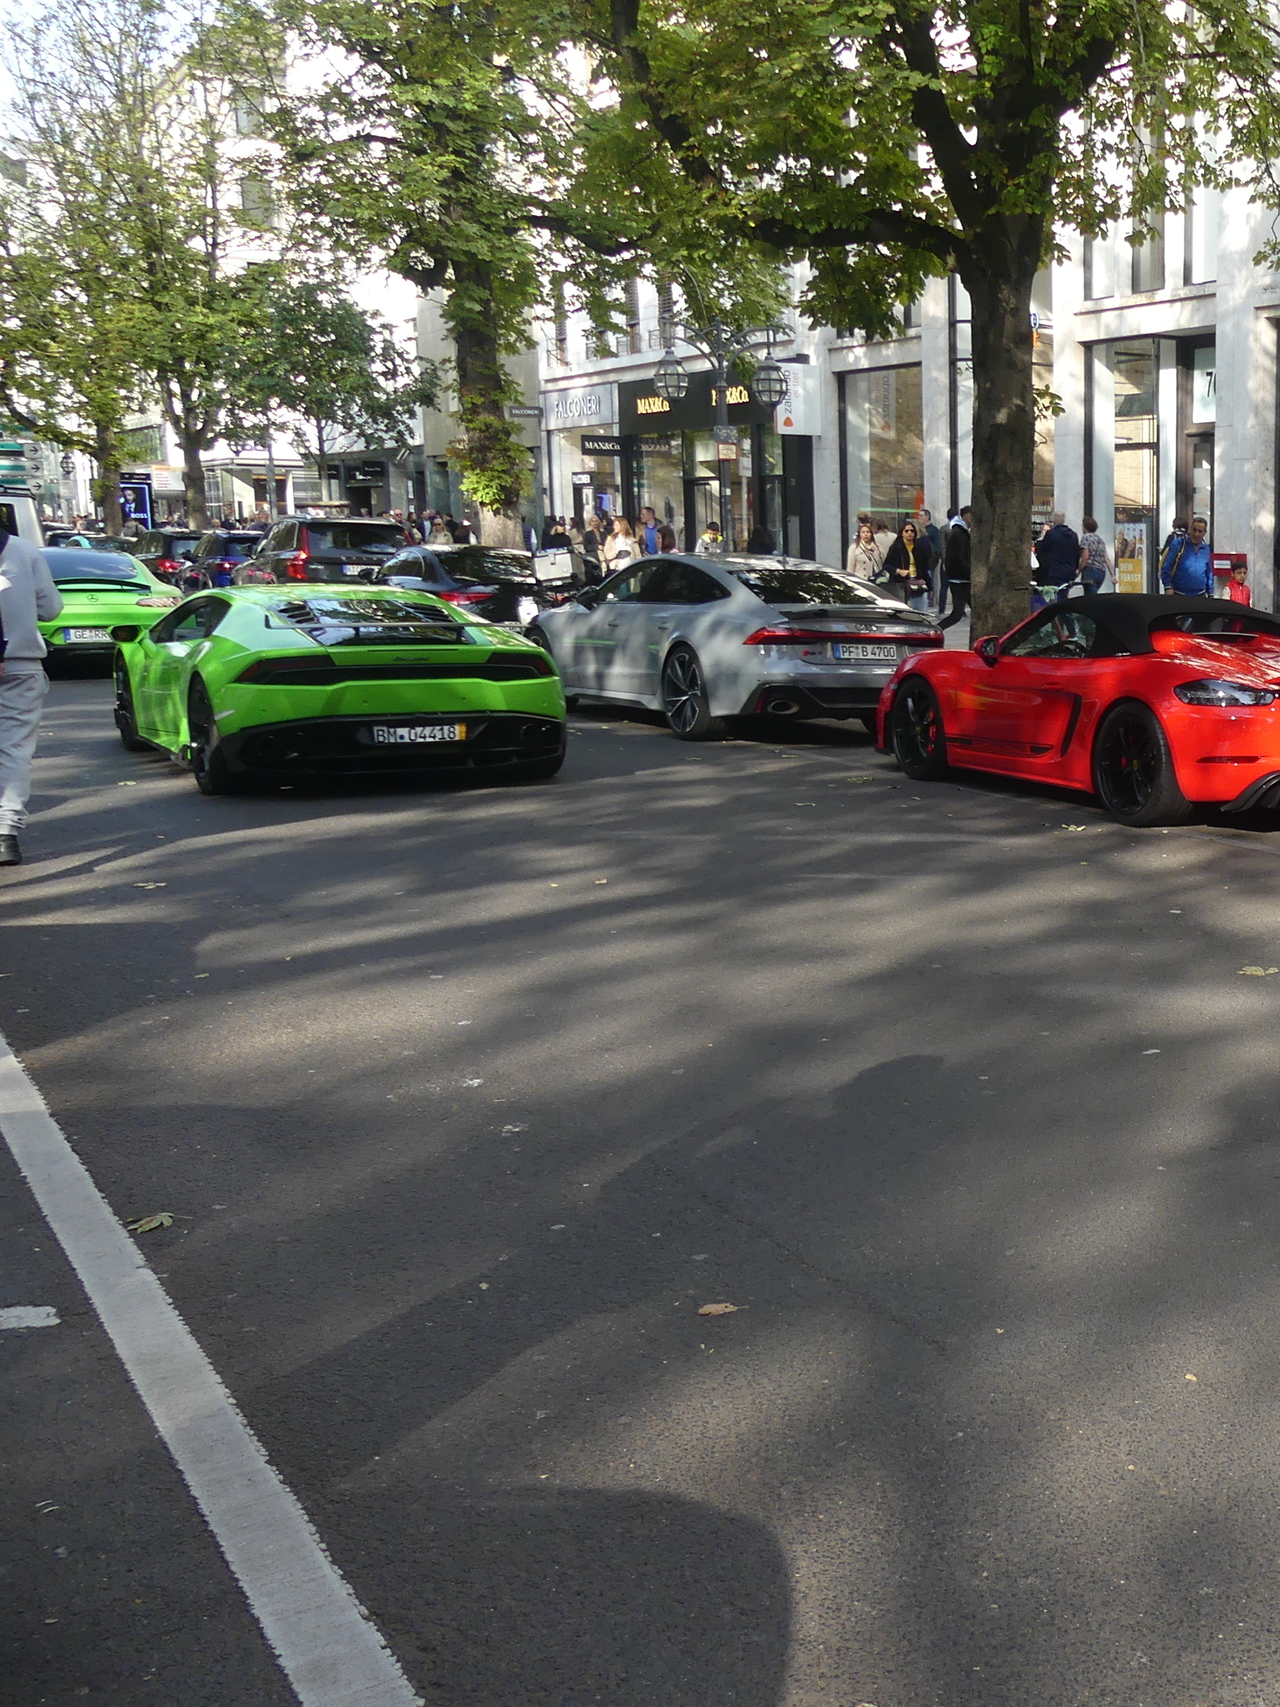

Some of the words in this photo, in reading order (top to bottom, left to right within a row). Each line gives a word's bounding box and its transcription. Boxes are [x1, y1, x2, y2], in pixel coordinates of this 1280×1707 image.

[554, 395, 600, 419] FALCONERI
[74, 630, 88, 640] GE
[842, 646, 854, 656] PF
[862, 646, 868, 656] B
[871, 647, 895, 657] 4700
